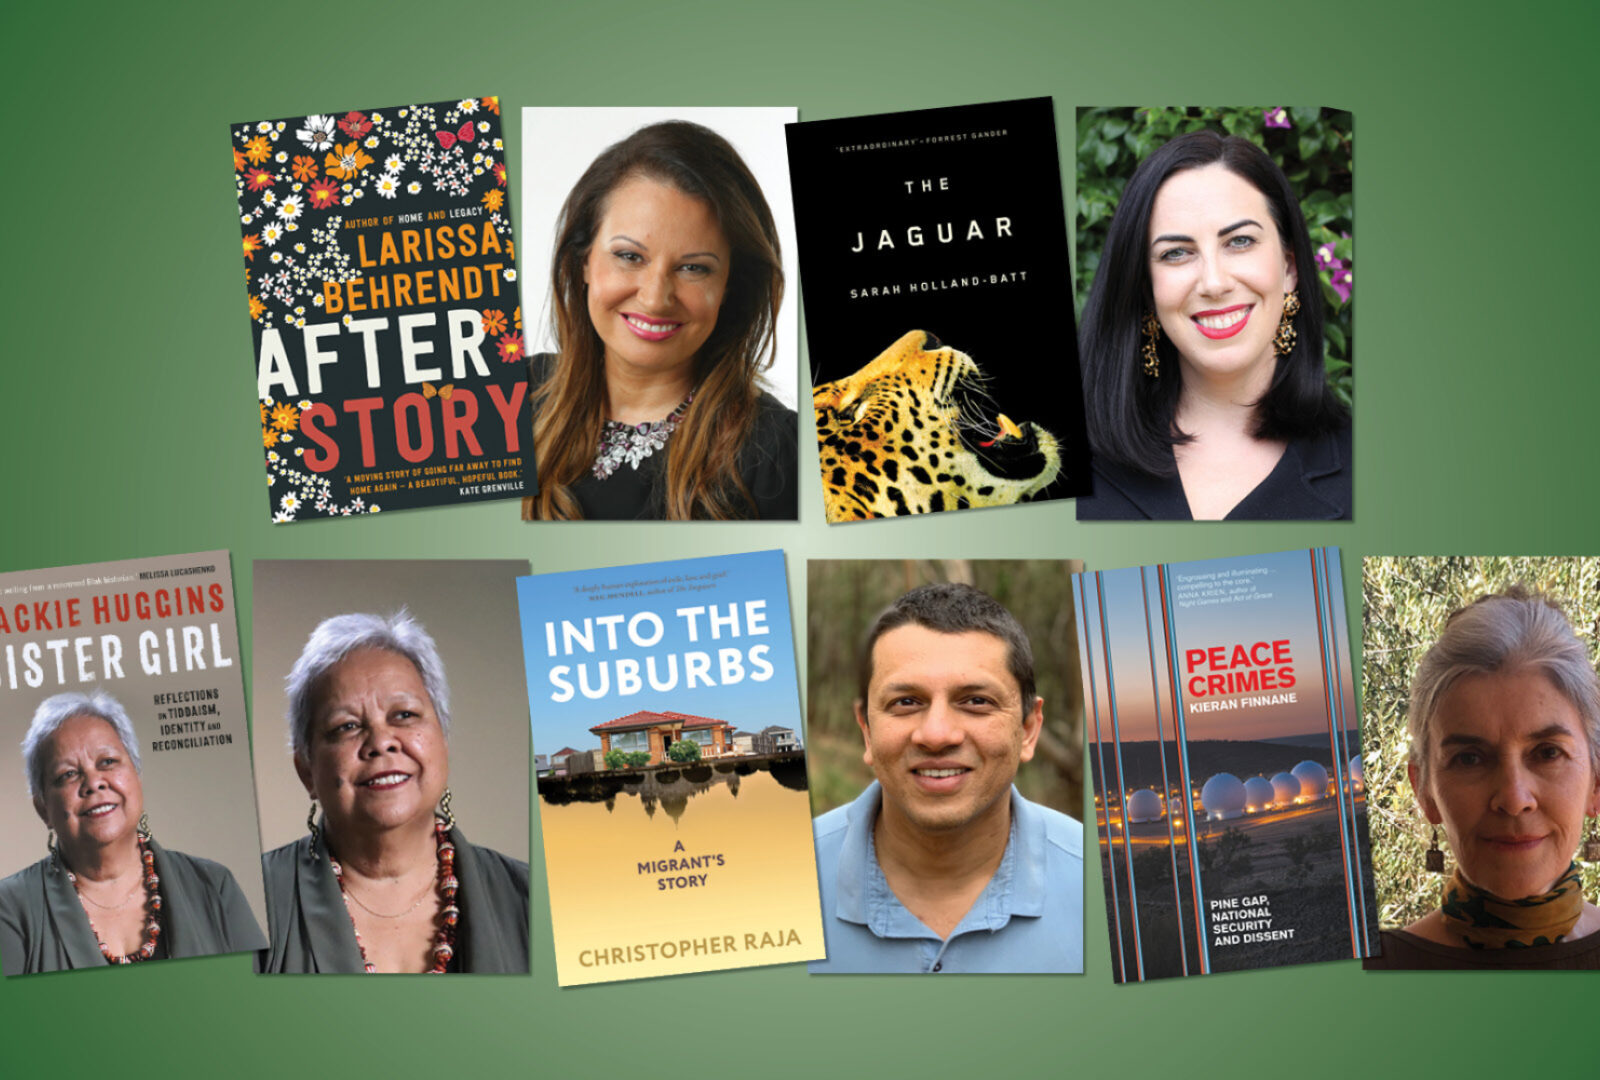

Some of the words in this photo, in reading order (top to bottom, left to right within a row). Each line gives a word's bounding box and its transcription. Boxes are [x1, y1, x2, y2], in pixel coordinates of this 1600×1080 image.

[971, 129, 1007, 140] GANDER
[904, 177, 949, 194] THE
[345, 217, 379, 229] AUTHOR
[383, 216, 394, 226] OF
[398, 213, 423, 224] HOME
[427, 210, 446, 221] AND
[449, 206, 483, 219] LEGACY
[357, 221, 502, 268] LARISSA
[851, 216, 1013, 252] JAGUAR
[323, 263, 504, 314] BEHRENDT
[850, 284, 901, 299] SARAH
[909, 271, 1027, 293] HOLLAND-BATT
[258, 308, 491, 400] AFTER
[299, 381, 529, 473] STORY
[353, 472, 383, 483] MOVING
[385, 469, 410, 480] STORY
[412, 467, 422, 477] OF
[424, 465, 447, 476] GOING
[449, 463, 464, 473] FAR
[466, 461, 489, 471] AWAY
[491, 460, 502, 469] TO
[503, 457, 522, 467] FIND
[350, 485, 372, 496] HOME
[374, 482, 398, 493] AGAIN
[408, 480, 414, 490] A
[462, 472, 496, 483] HOPEFUL
[459, 485, 480, 496] KATE
[481, 481, 524, 494] GRENVILLE
[139, 569, 169, 580] MELISSA
[170, 564, 216, 577] LUCASHENKO
[92, 583, 225, 625] HUGGINS
[1178, 590, 1199, 600] ANNA
[545, 611, 665, 657] INTO
[676, 599, 770, 642] THE
[0, 634, 125, 690] ISTER
[138, 622, 233, 676] GIRL
[1185, 639, 1293, 674] PEACE
[548, 644, 775, 703] SUBURBS
[1188, 666, 1297, 698] CRIMES
[153, 688, 219, 705] REFLECTIONS
[1190, 698, 1238, 714] KIERAN
[1241, 692, 1298, 709] FINNANE
[158, 712, 167, 721] ON
[167, 703, 220, 719] TIDDAISM,
[160, 720, 206, 736] IDENTITY
[207, 722, 221, 731] AND
[152, 733, 233, 752] RECONCILIATION
[673, 839, 685, 853] A
[637, 853, 725, 875] MIGRANT'S
[657, 873, 708, 891] STORY
[1210, 898, 1240, 910] PINE
[1241, 895, 1270, 907] GAP,
[1211, 906, 1272, 922] NATIONAL
[1212, 918, 1273, 934] SECURITY
[578, 934, 737, 968] CHRISTOPHER
[744, 928, 802, 951] RAJA
[1214, 934, 1241, 947] AND
[1243, 928, 1295, 944] DISSENT
